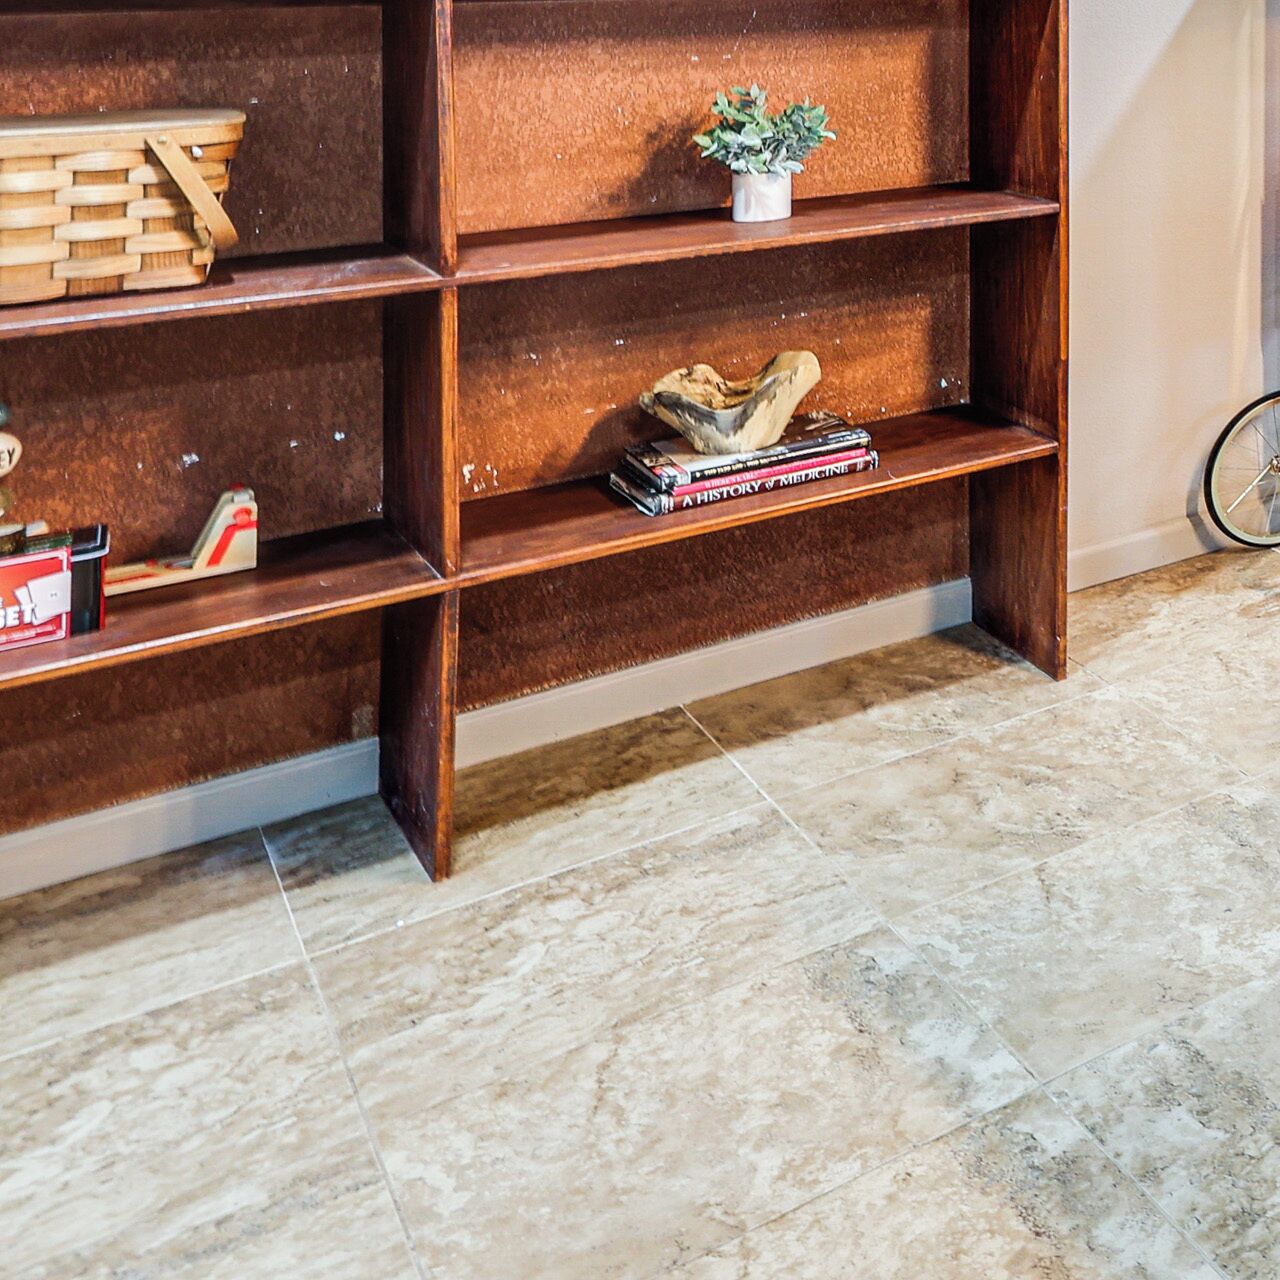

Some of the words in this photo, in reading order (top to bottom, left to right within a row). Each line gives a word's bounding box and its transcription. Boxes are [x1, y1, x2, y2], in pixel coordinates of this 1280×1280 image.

[682, 495, 693, 508] A
[697, 480, 762, 504] HISTORY
[780, 465, 849, 487] MEDICINE
